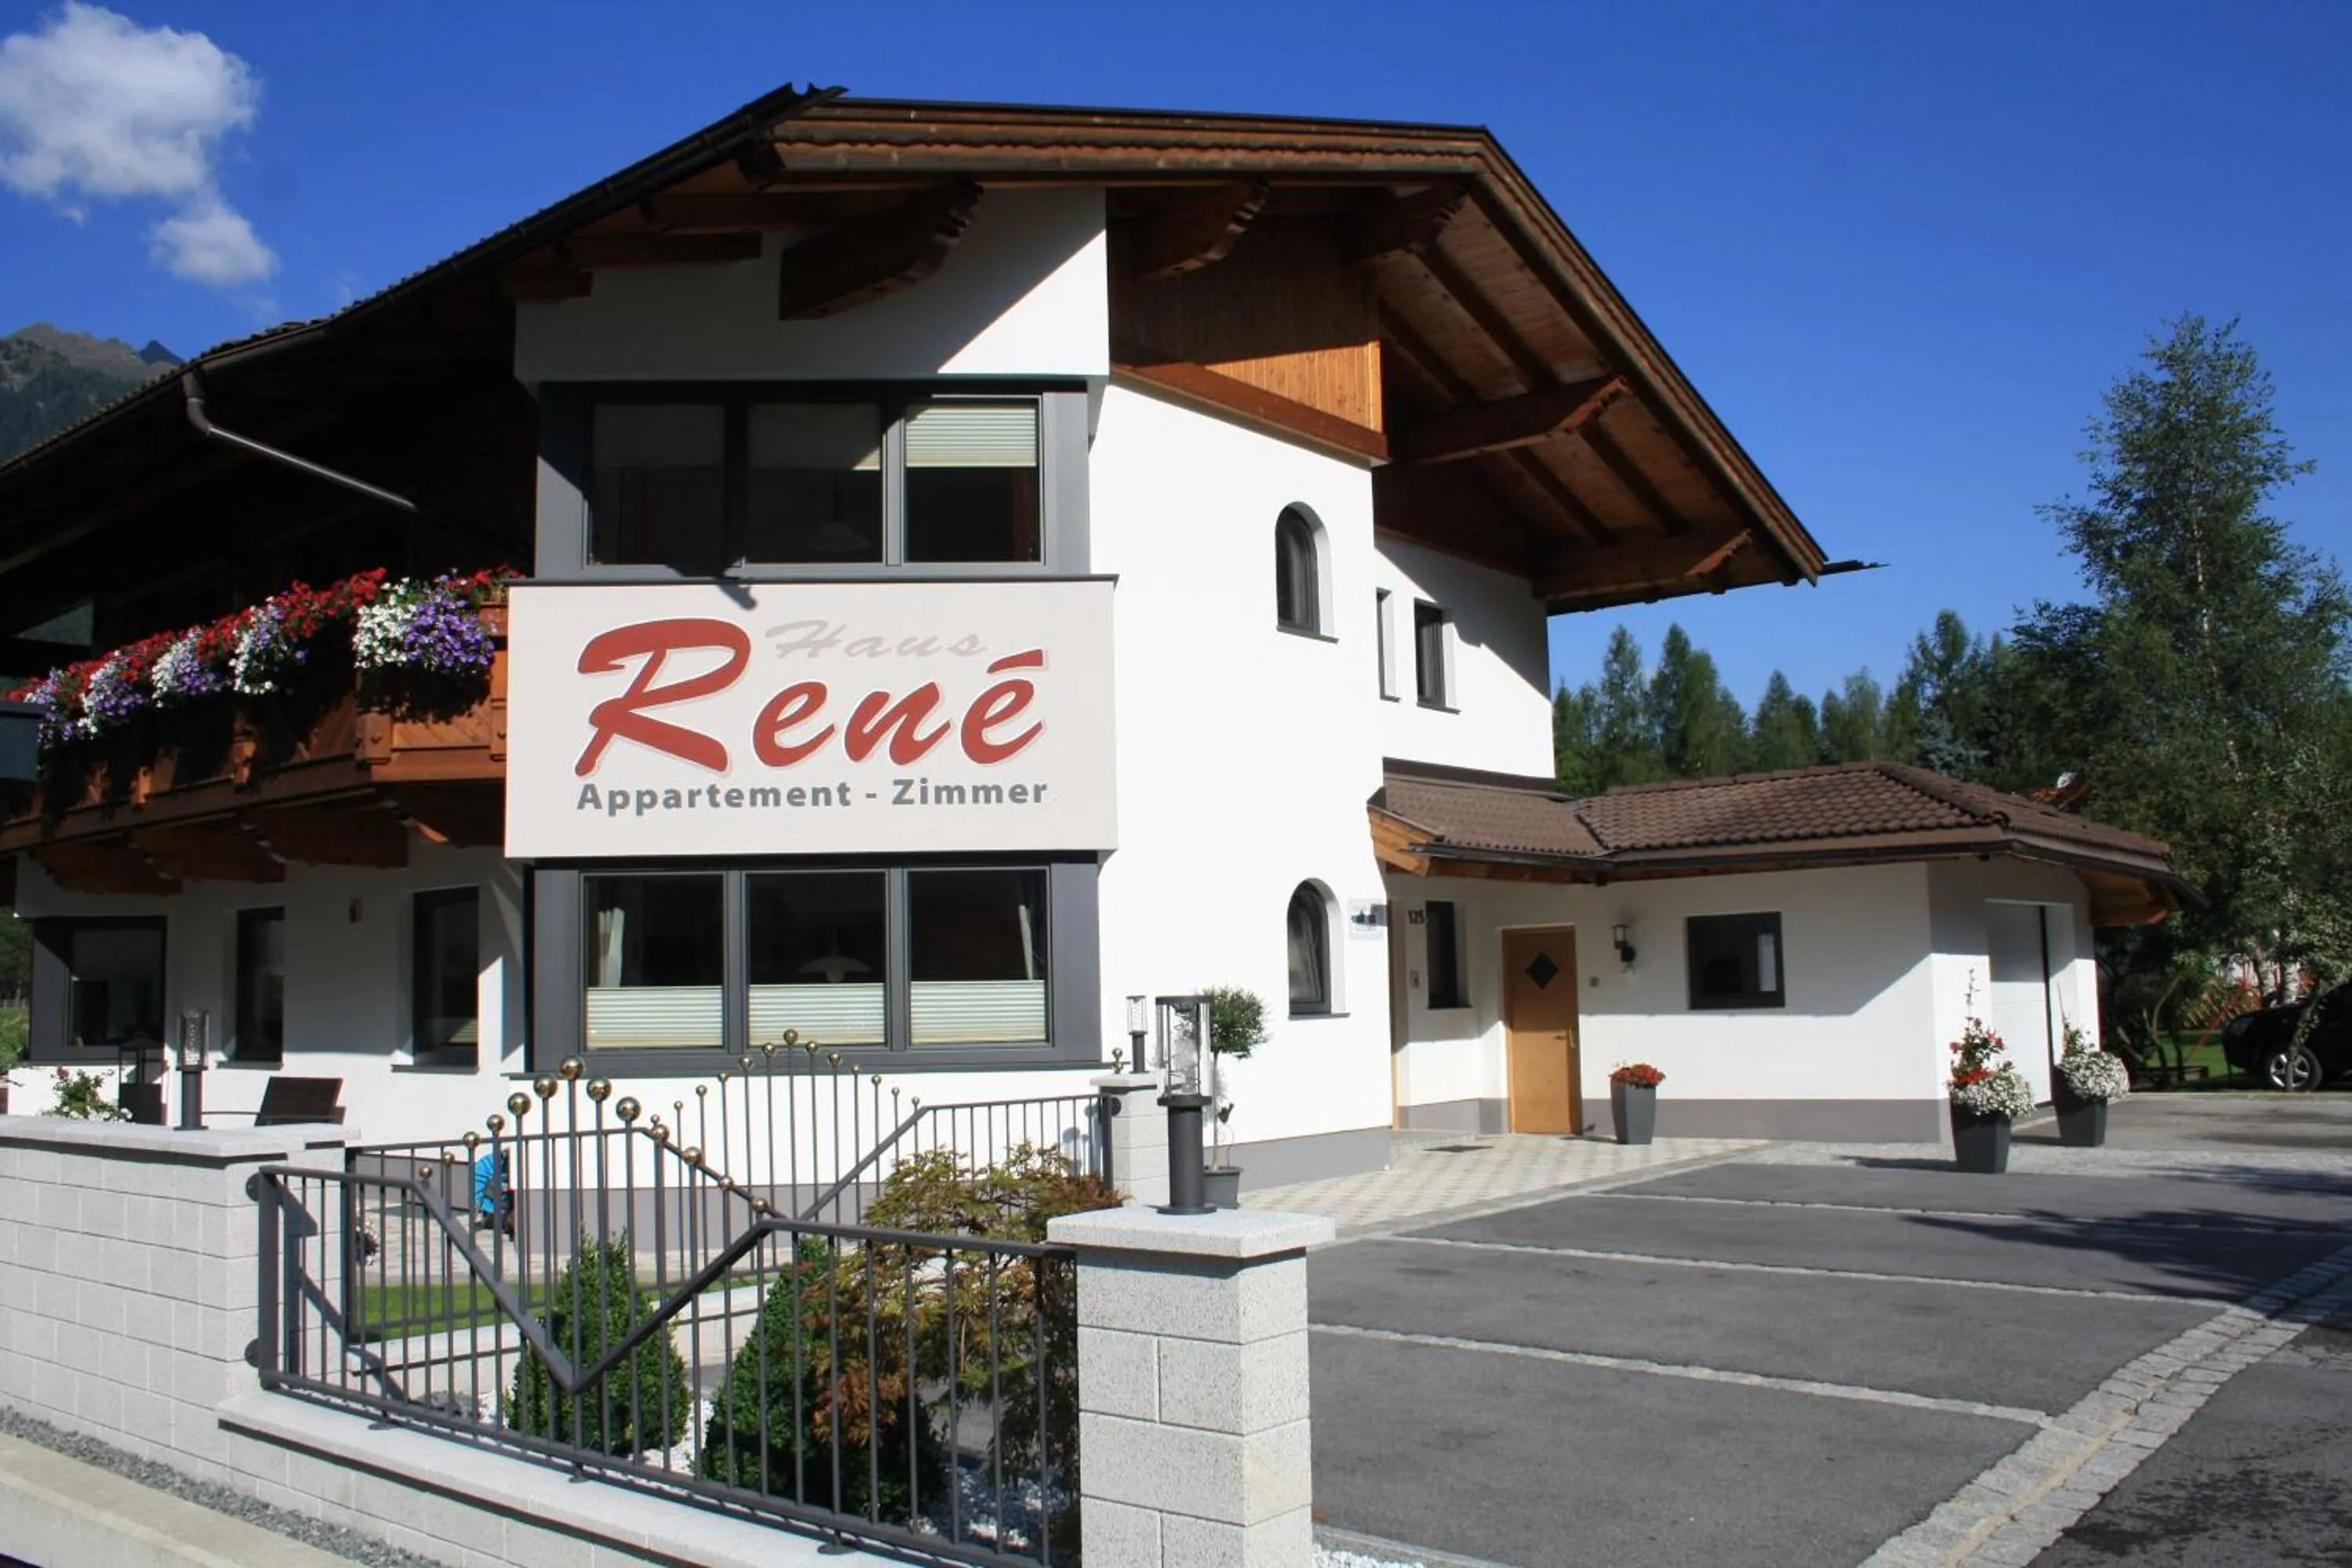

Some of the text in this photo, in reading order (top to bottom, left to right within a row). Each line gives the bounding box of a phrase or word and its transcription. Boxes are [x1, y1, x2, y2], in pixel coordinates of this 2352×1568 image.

[764, 619, 988, 660] Haus
[575, 618, 1045, 776] René
[576, 782, 851, 815] Appartement
[891, 777, 1047, 804] Zimmer
